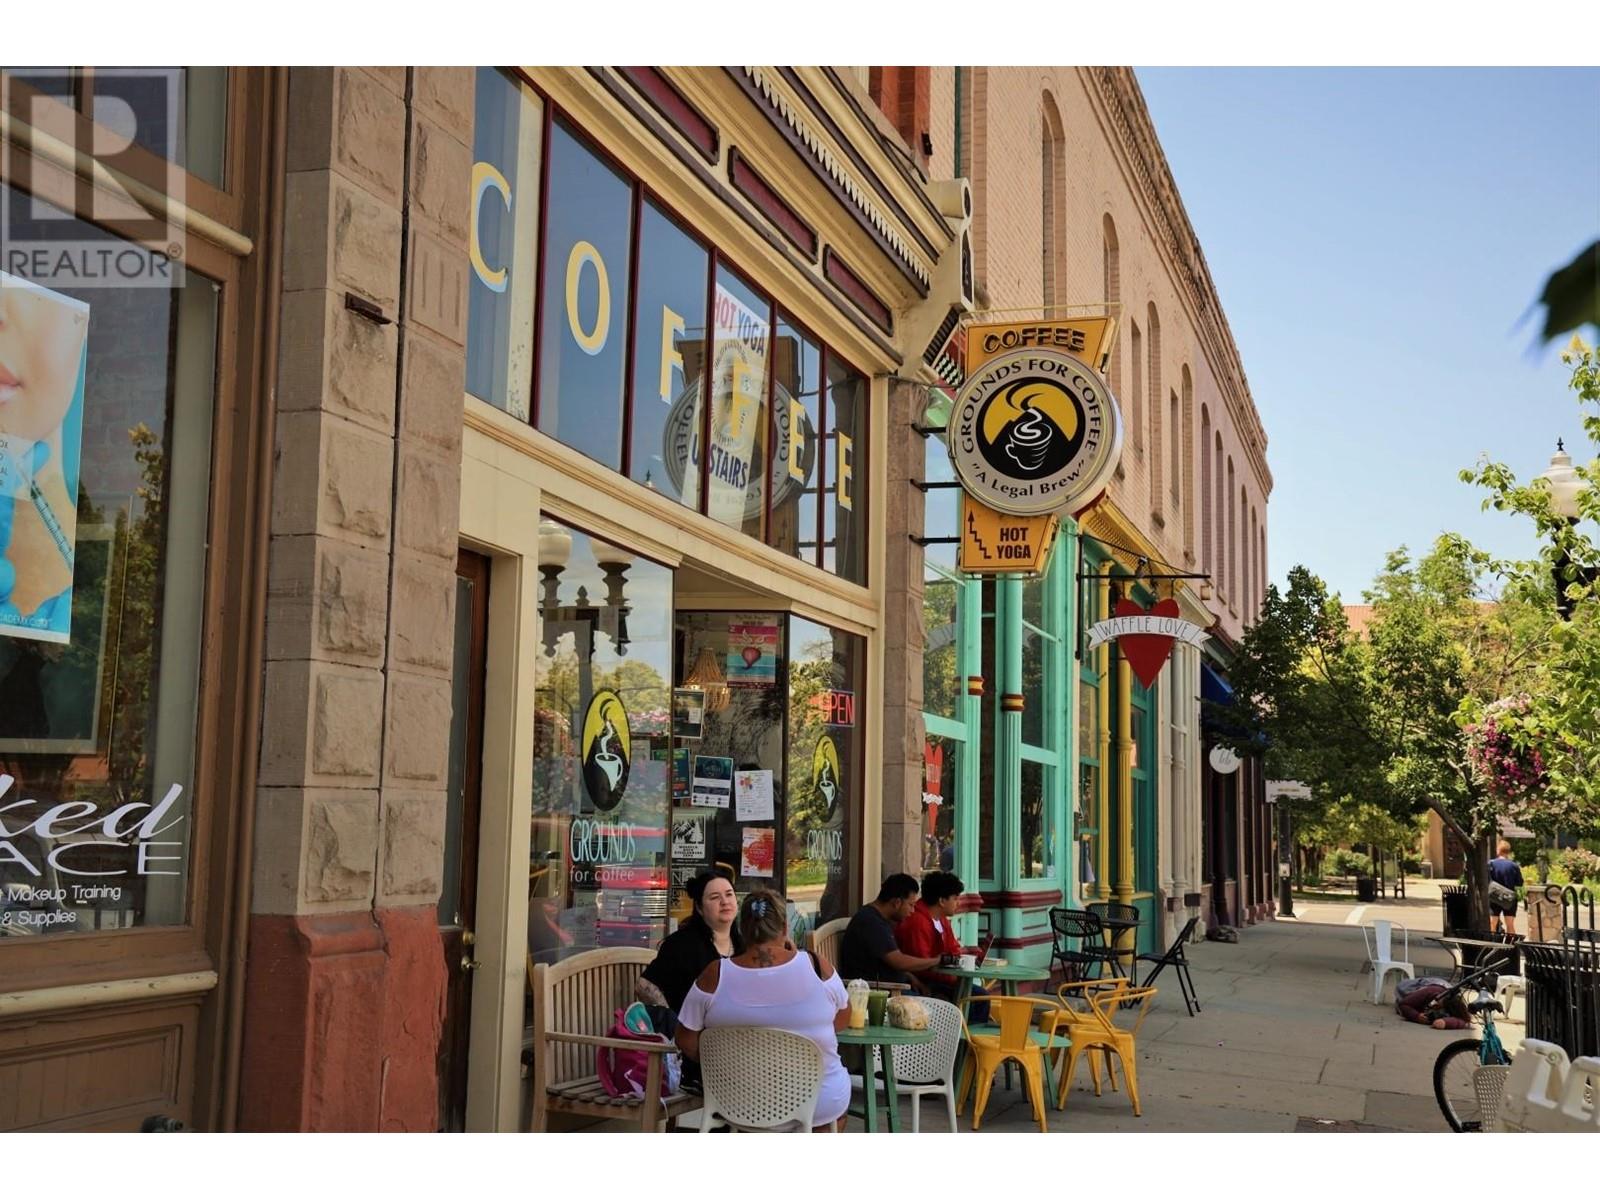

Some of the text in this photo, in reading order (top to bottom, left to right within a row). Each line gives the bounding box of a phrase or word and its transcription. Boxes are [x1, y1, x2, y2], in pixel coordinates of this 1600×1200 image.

[735, 307, 765, 357] YOGA
[984, 328, 1086, 353] COFFEE
[961, 358, 1101, 454] GROUNDS FOR COFFEE
[691, 434, 748, 490] USTAIRS
[991, 479, 1033, 498] Legal
[1000, 528, 1028, 541] HOT
[996, 545, 1031, 559] YOGA
[1101, 616, 1191, 639] WAFFLE LOVE
[0, 773, 184, 838] ked
[570, 819, 636, 862] GROUNDS
[0, 840, 182, 876] ACE
[570, 865, 635, 883] for coffee
[8, 887, 67, 902] Makeup
[71, 884, 122, 901] Training
[2, 908, 77, 926] & Supplies
